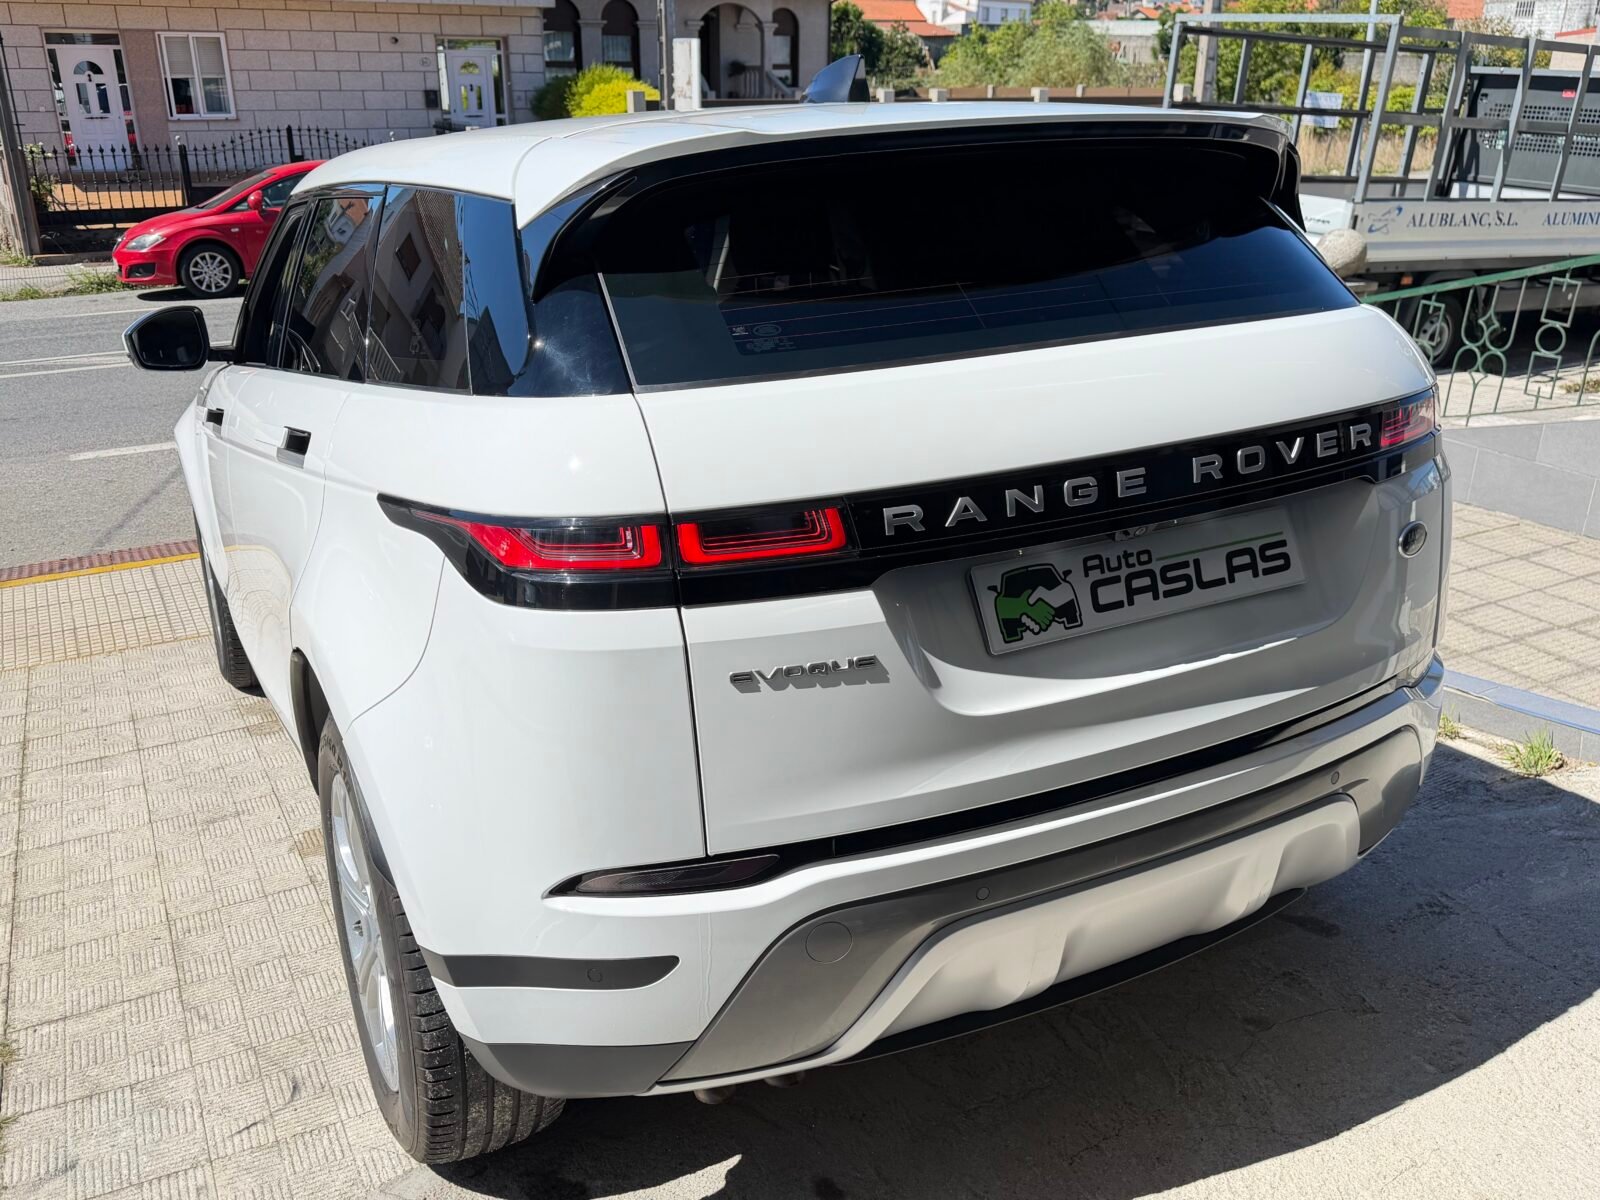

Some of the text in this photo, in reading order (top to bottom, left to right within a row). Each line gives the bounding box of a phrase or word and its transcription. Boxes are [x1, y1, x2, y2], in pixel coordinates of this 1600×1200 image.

[1407, 210, 1519, 229] ALUBLANC, S.L.
[883, 422, 1373, 536] RANGE ROVER
[1082, 548, 1153, 578] Auto
[1090, 539, 1292, 614] CASLAS
[729, 654, 878, 685] EVOQUE
